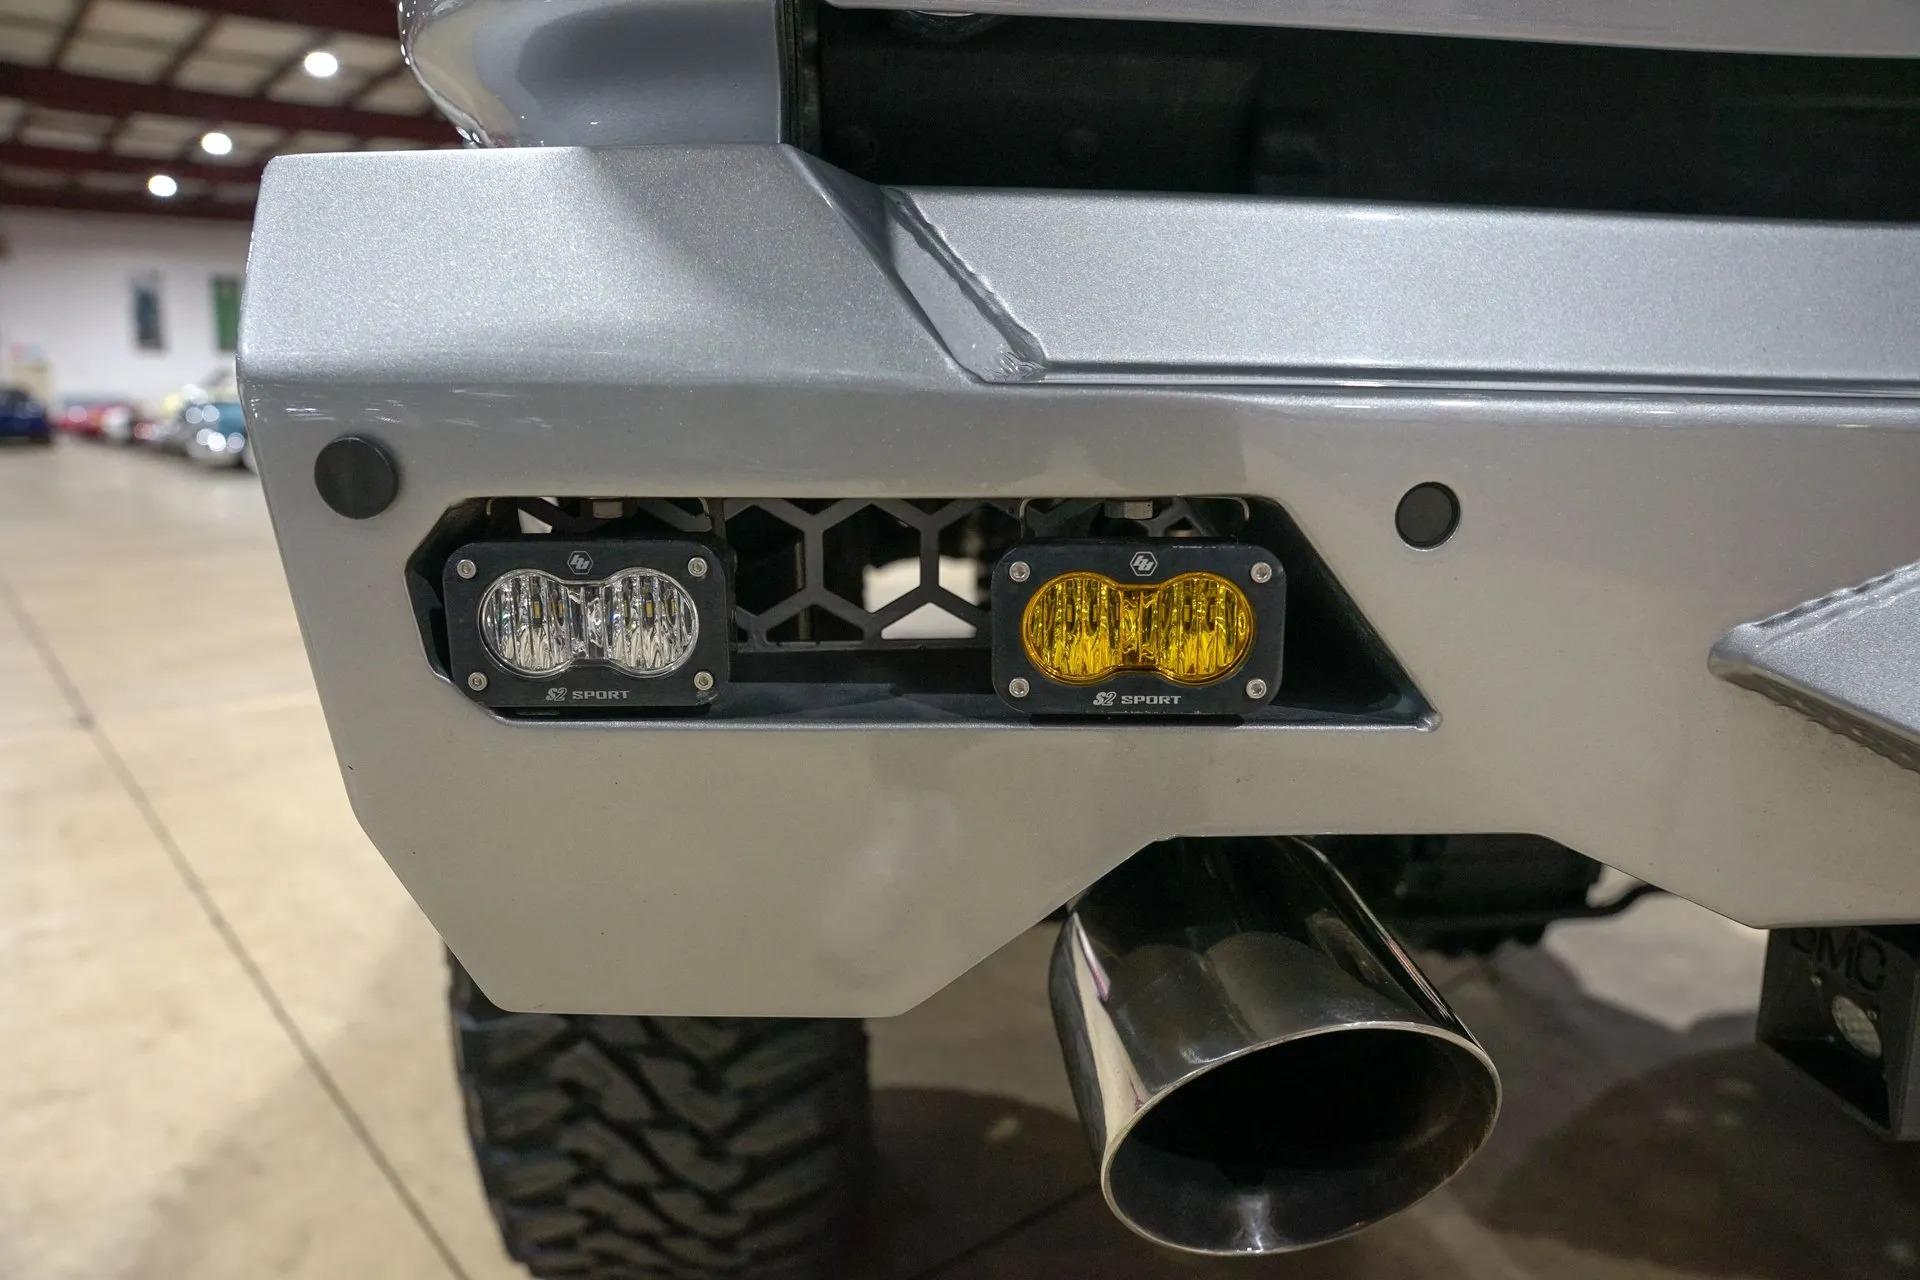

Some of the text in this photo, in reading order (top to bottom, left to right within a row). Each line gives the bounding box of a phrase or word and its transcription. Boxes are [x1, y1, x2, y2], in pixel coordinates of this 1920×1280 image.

[546, 687, 630, 701] S2 SPORT
[1093, 691, 1182, 706] S2 SPORT
